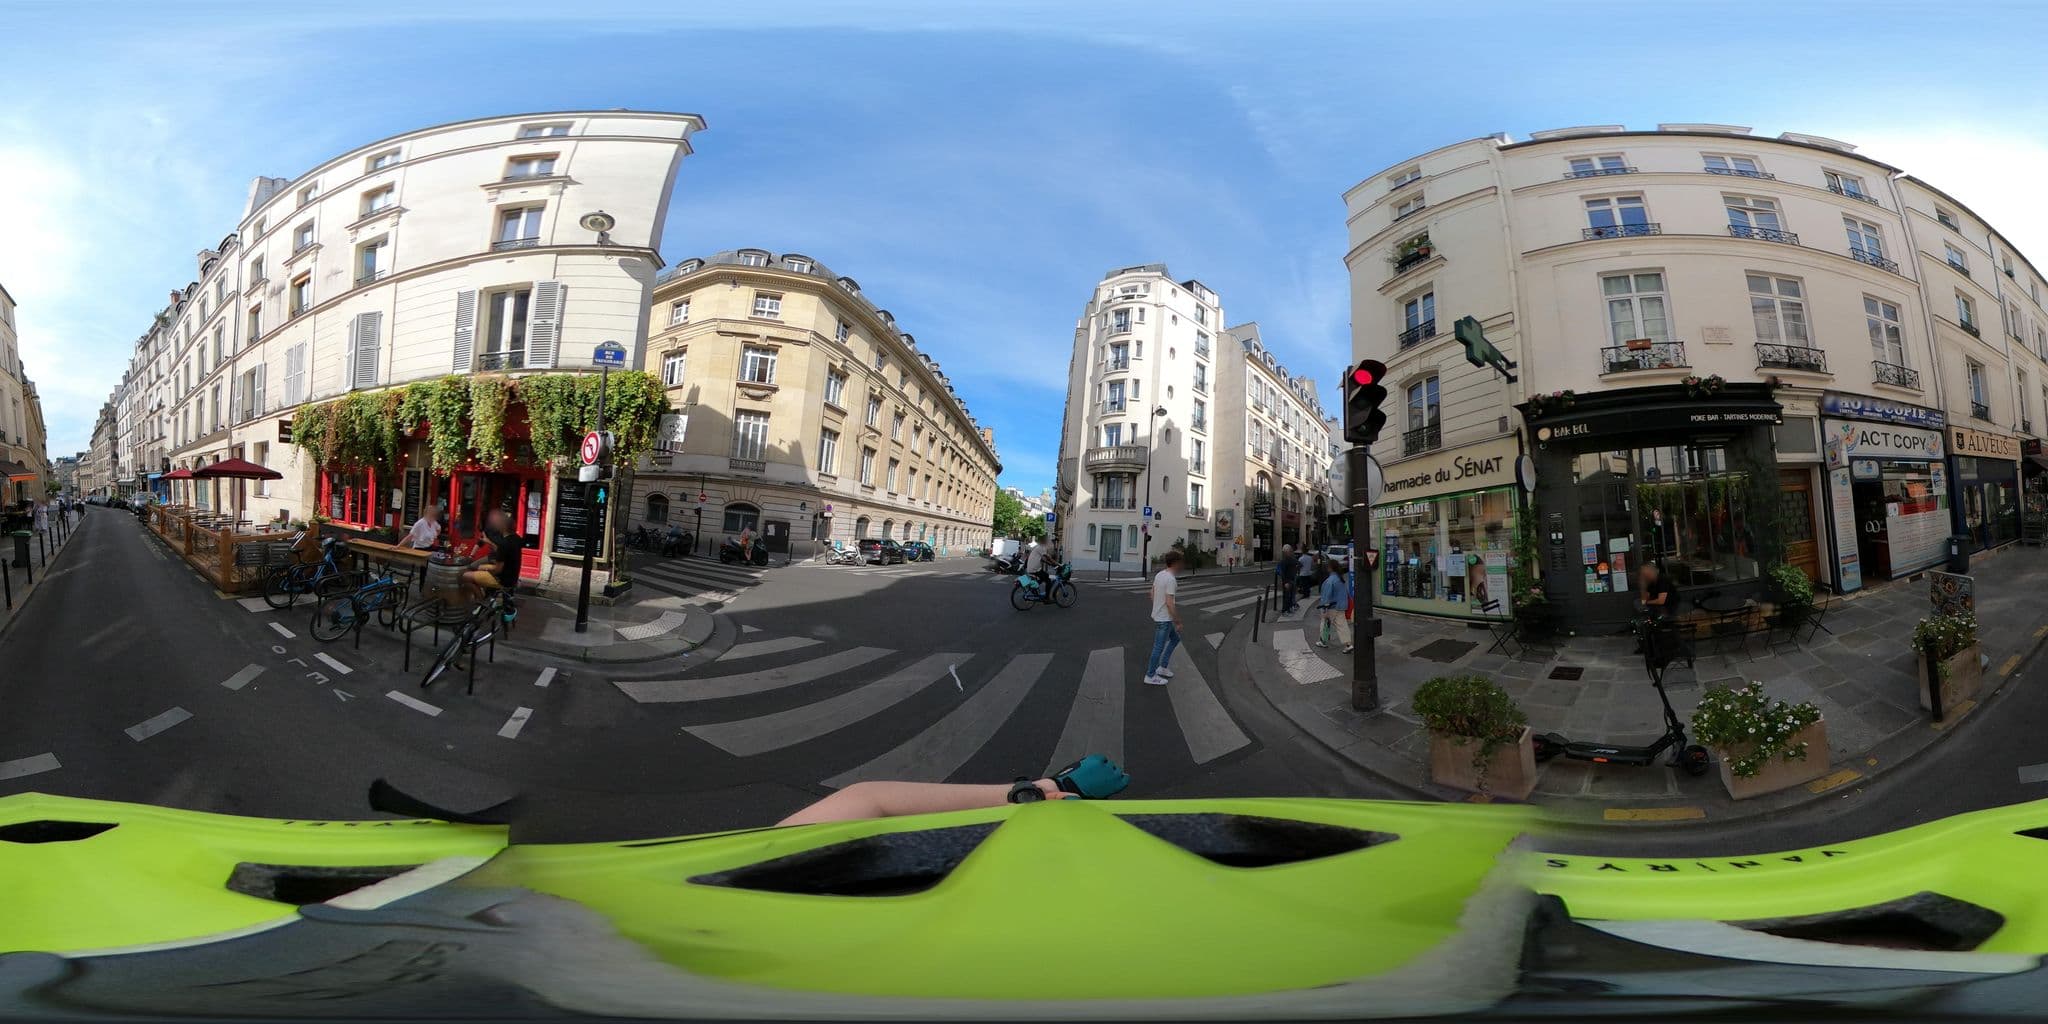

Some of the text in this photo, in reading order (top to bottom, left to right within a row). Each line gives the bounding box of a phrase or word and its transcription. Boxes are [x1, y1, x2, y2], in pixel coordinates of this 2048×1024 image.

[1554, 426, 1571, 438] BAR
[1860, 430, 1926, 451] ACT COPY
[1968, 435, 2009, 455] ALVEUS
[1384, 455, 1503, 493] harmacie du SÉNAT
